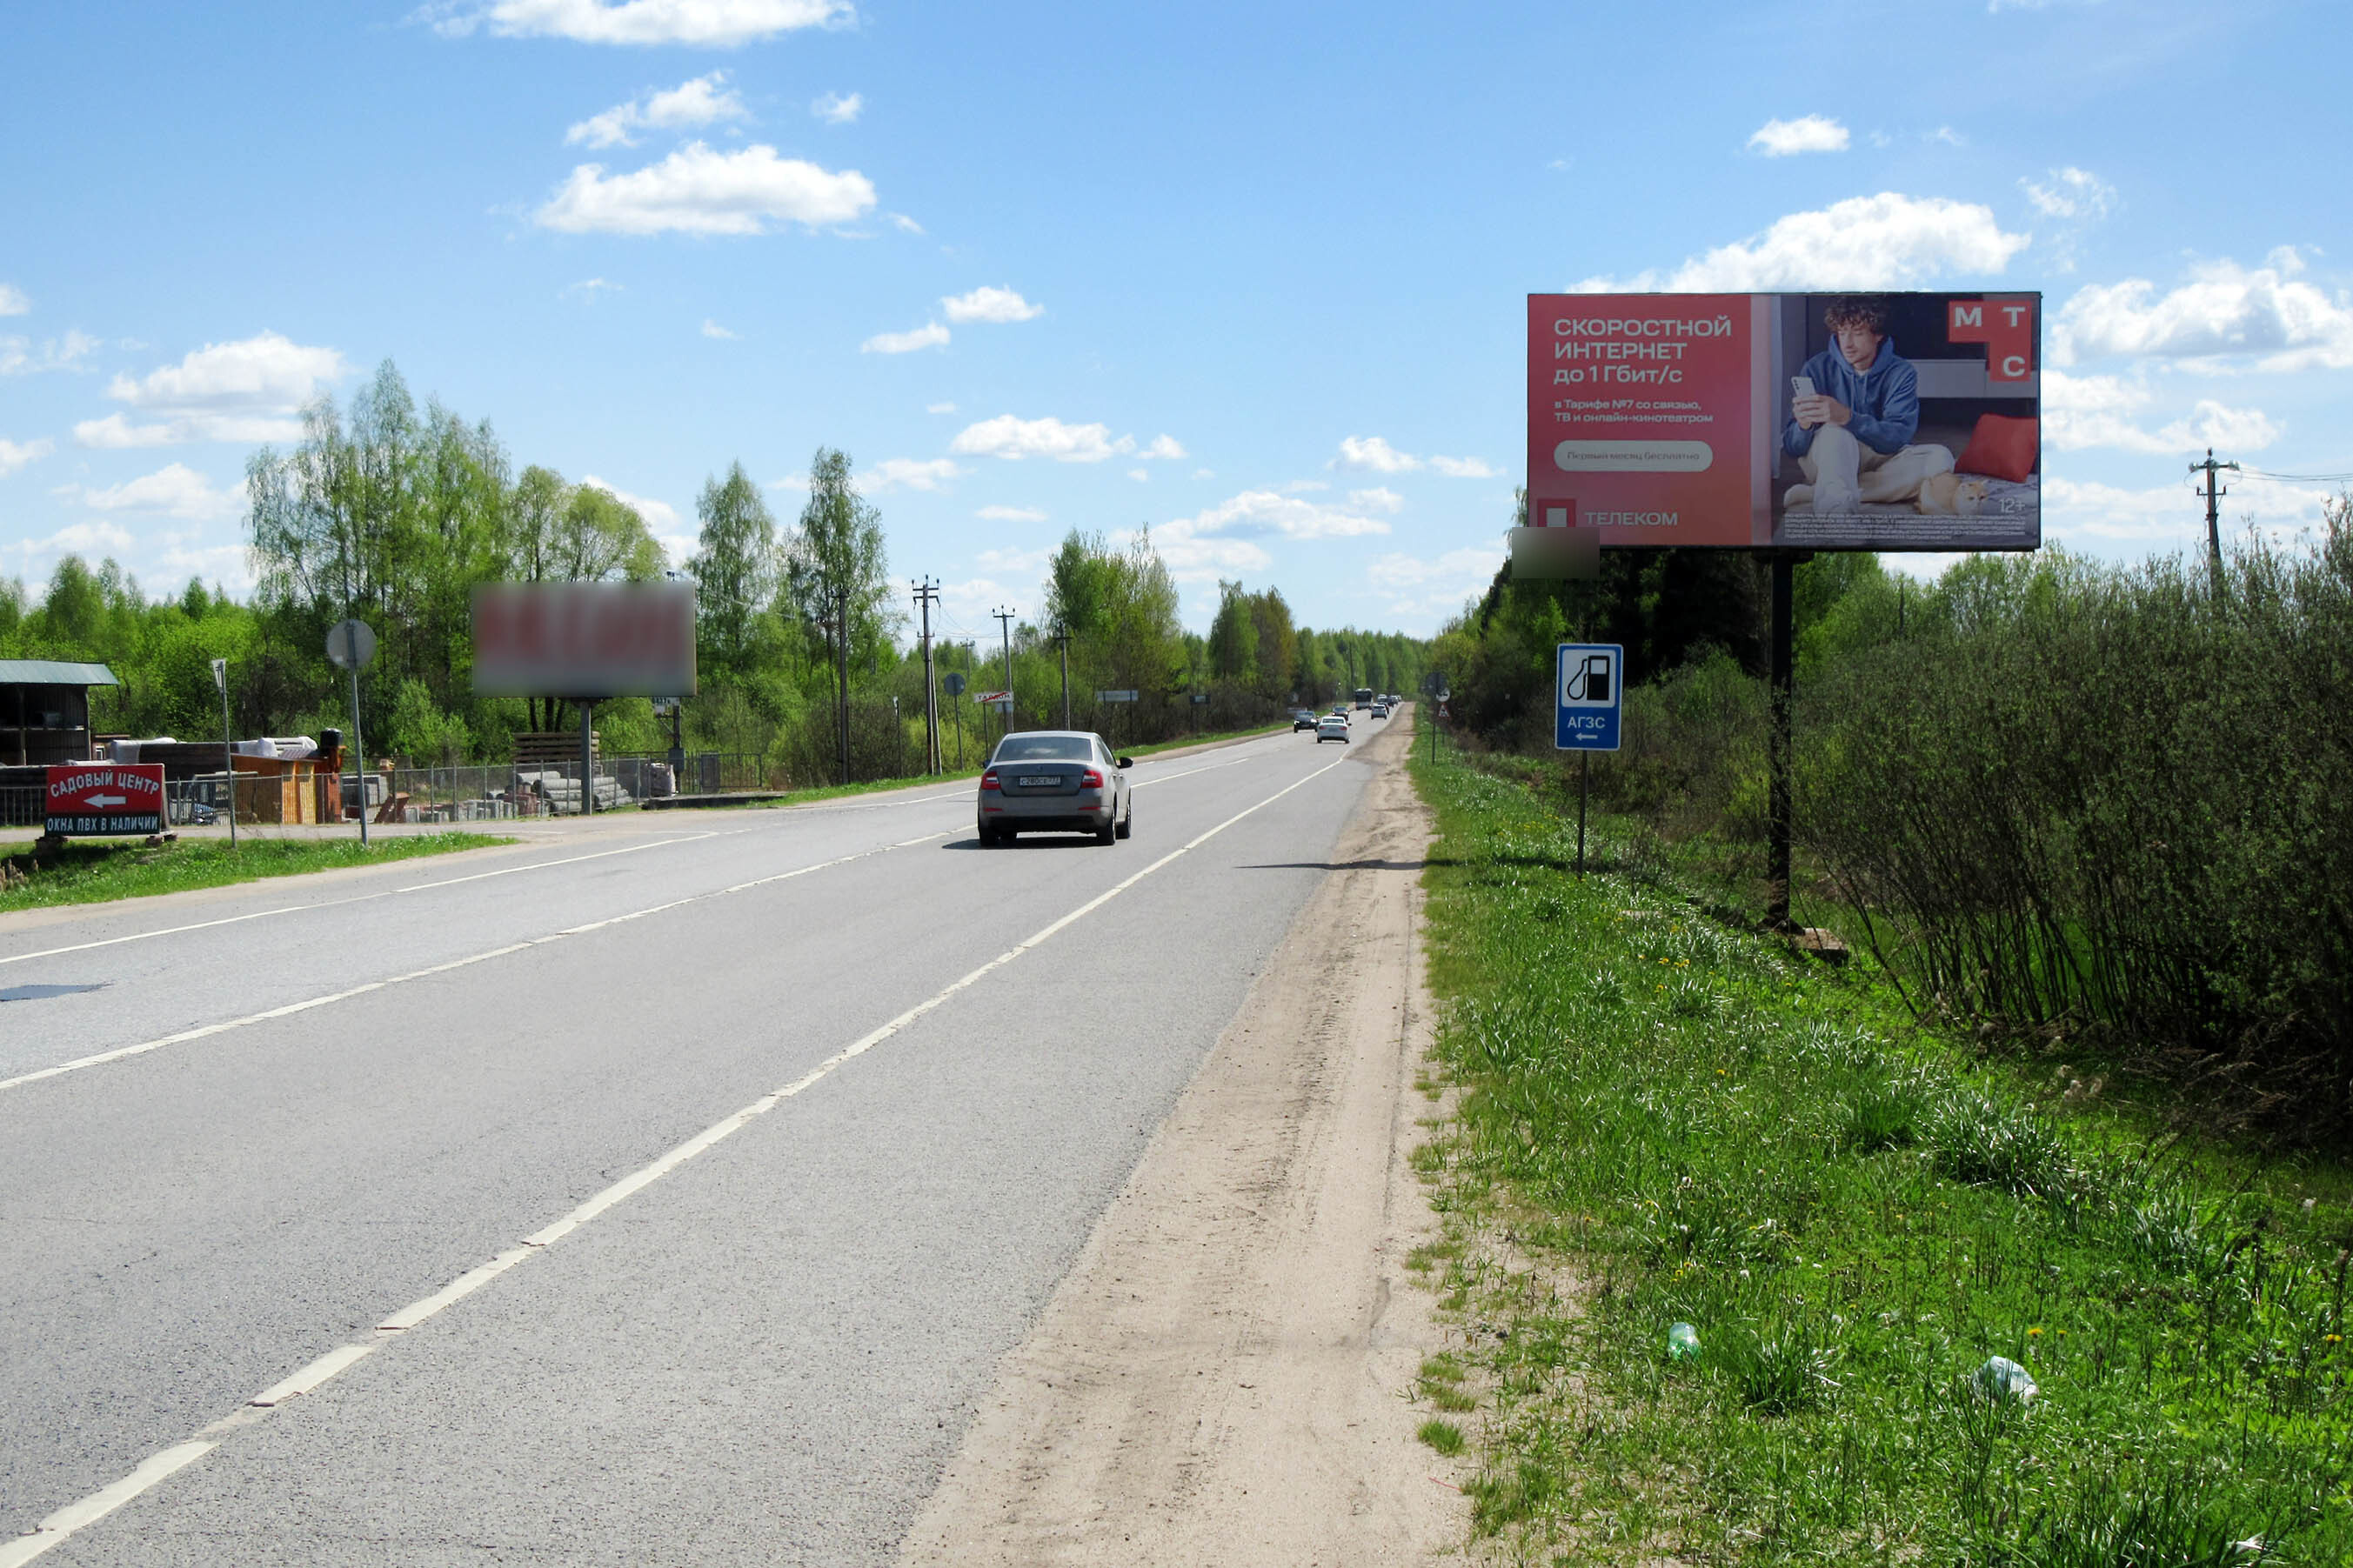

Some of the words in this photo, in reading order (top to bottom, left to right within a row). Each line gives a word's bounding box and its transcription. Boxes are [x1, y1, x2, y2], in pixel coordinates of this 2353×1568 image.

[1554, 316, 1733, 337] СКОРОСТНОЙ
[1554, 342, 1688, 359] ИНТЕРНЕТ
[1553, 369, 1585, 384] до
[1604, 364, 1683, 384] Гбит/с
[1554, 401, 1562, 410] в
[1612, 399, 1634, 410] №7
[1636, 401, 1651, 410] со
[1653, 401, 1702, 411] связью,
[1554, 413, 1571, 423] ТВ
[1583, 412, 1714, 424] онлайн-кинотеатром
[2000, 497, 2026, 513] 12+
[1584, 511, 1679, 526] ТЕЛЕКОМ
[1568, 716, 1606, 729] АГЗС
[50, 769, 114, 797] САДОВЫЙ
[117, 772, 160, 795] ЦЕНТР
[47, 817, 74, 831] ОКНА
[77, 817, 97, 831] ПВХ
[100, 817, 107, 831] В
[110, 816, 158, 831] НАЛИЧИИ
